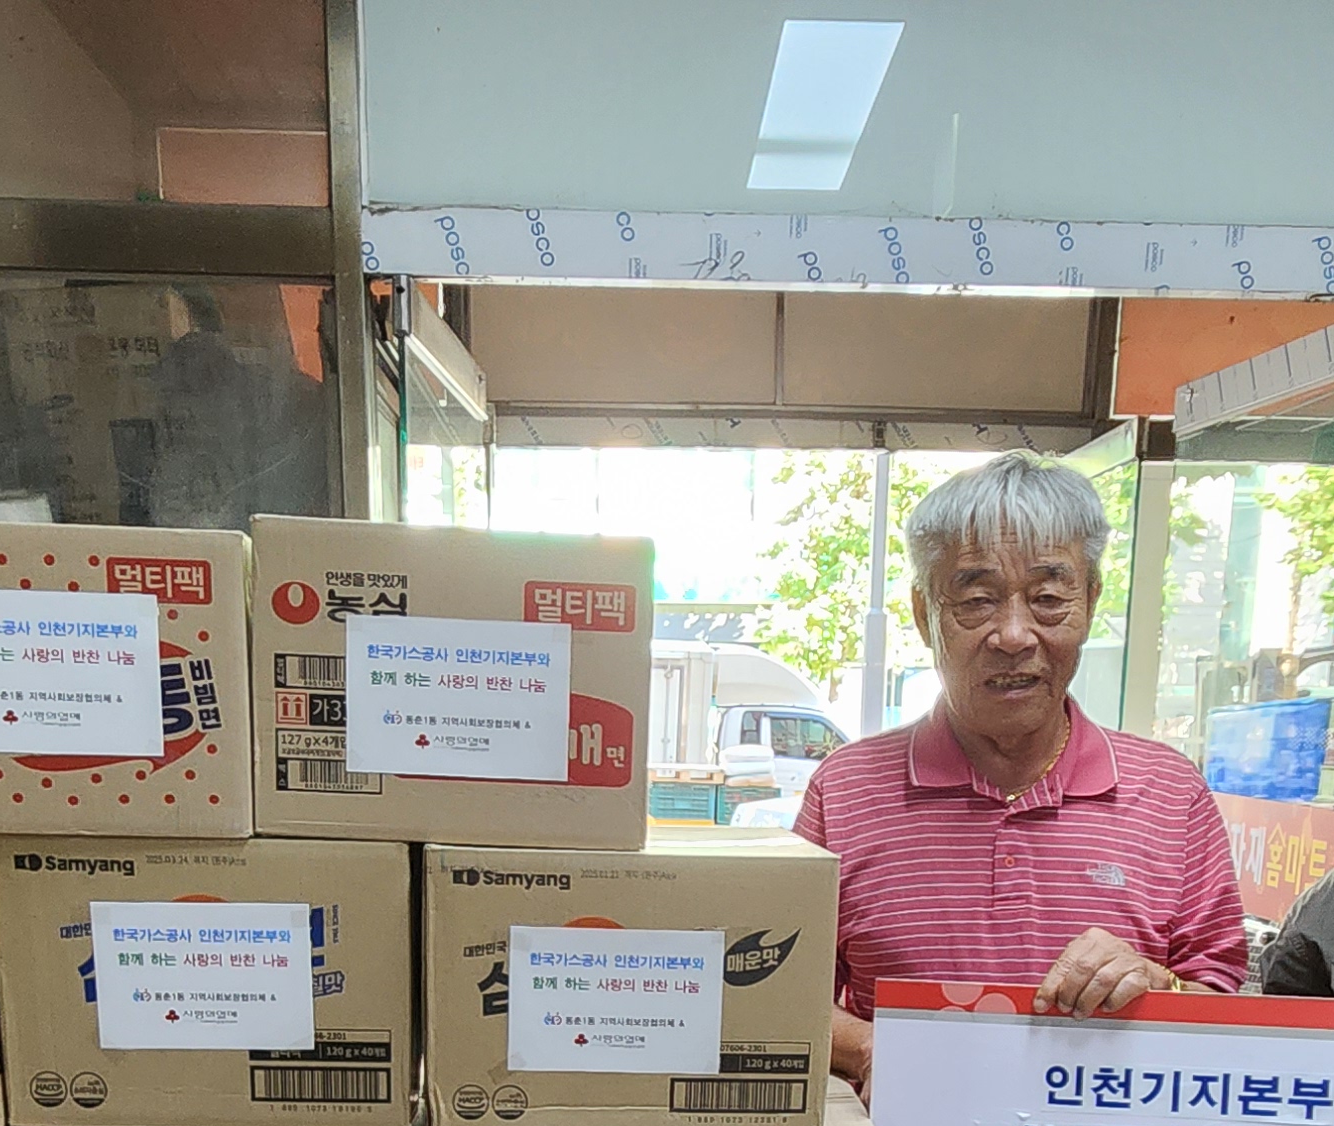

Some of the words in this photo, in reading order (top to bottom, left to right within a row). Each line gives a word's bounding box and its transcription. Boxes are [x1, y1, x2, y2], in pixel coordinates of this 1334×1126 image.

[113, 563, 206, 599] 멀티팩
[324, 571, 365, 587] 인생을
[366, 572, 409, 589] 맛있게
[533, 589, 627, 625] 멀티팩
[36, 620, 138, 640] 인천기지본부와
[20, 646, 65, 664] 사랑의
[71, 647, 101, 665] 반찬
[106, 649, 136, 666] 나눔
[365, 642, 449, 663] 한국가스공사
[454, 647, 551, 668] 인천기지본부와
[369, 669, 398, 686] 함께
[403, 671, 432, 688] 하는
[436, 672, 479, 691] 사랑의
[485, 675, 514, 692] 반찬
[518, 676, 547, 694] 나눔
[44, 854, 135, 877] Samyang
[481, 869, 572, 891] Samyang
[111, 927, 193, 944] 한국가스공사
[197, 927, 292, 944] 인천기지본부와
[116, 951, 145, 967] 함께
[149, 951, 177, 967] 하는
[182, 951, 223, 968] 사랑의
[228, 952, 256, 968] 반찬
[261, 952, 289, 968] 나눔
[528, 951, 608, 968] 한국가스공사
[613, 953, 705, 971] 인천기지본부와
[726, 947, 781, 973] 매운맛
[531, 975, 558, 990] 함께
[563, 975, 592, 992] 하는
[595, 976, 636, 993] 사랑의
[641, 978, 669, 993] 반찬
[673, 978, 701, 995] 나눔
[1043, 1063, 1334, 1120] 인천기지본부
